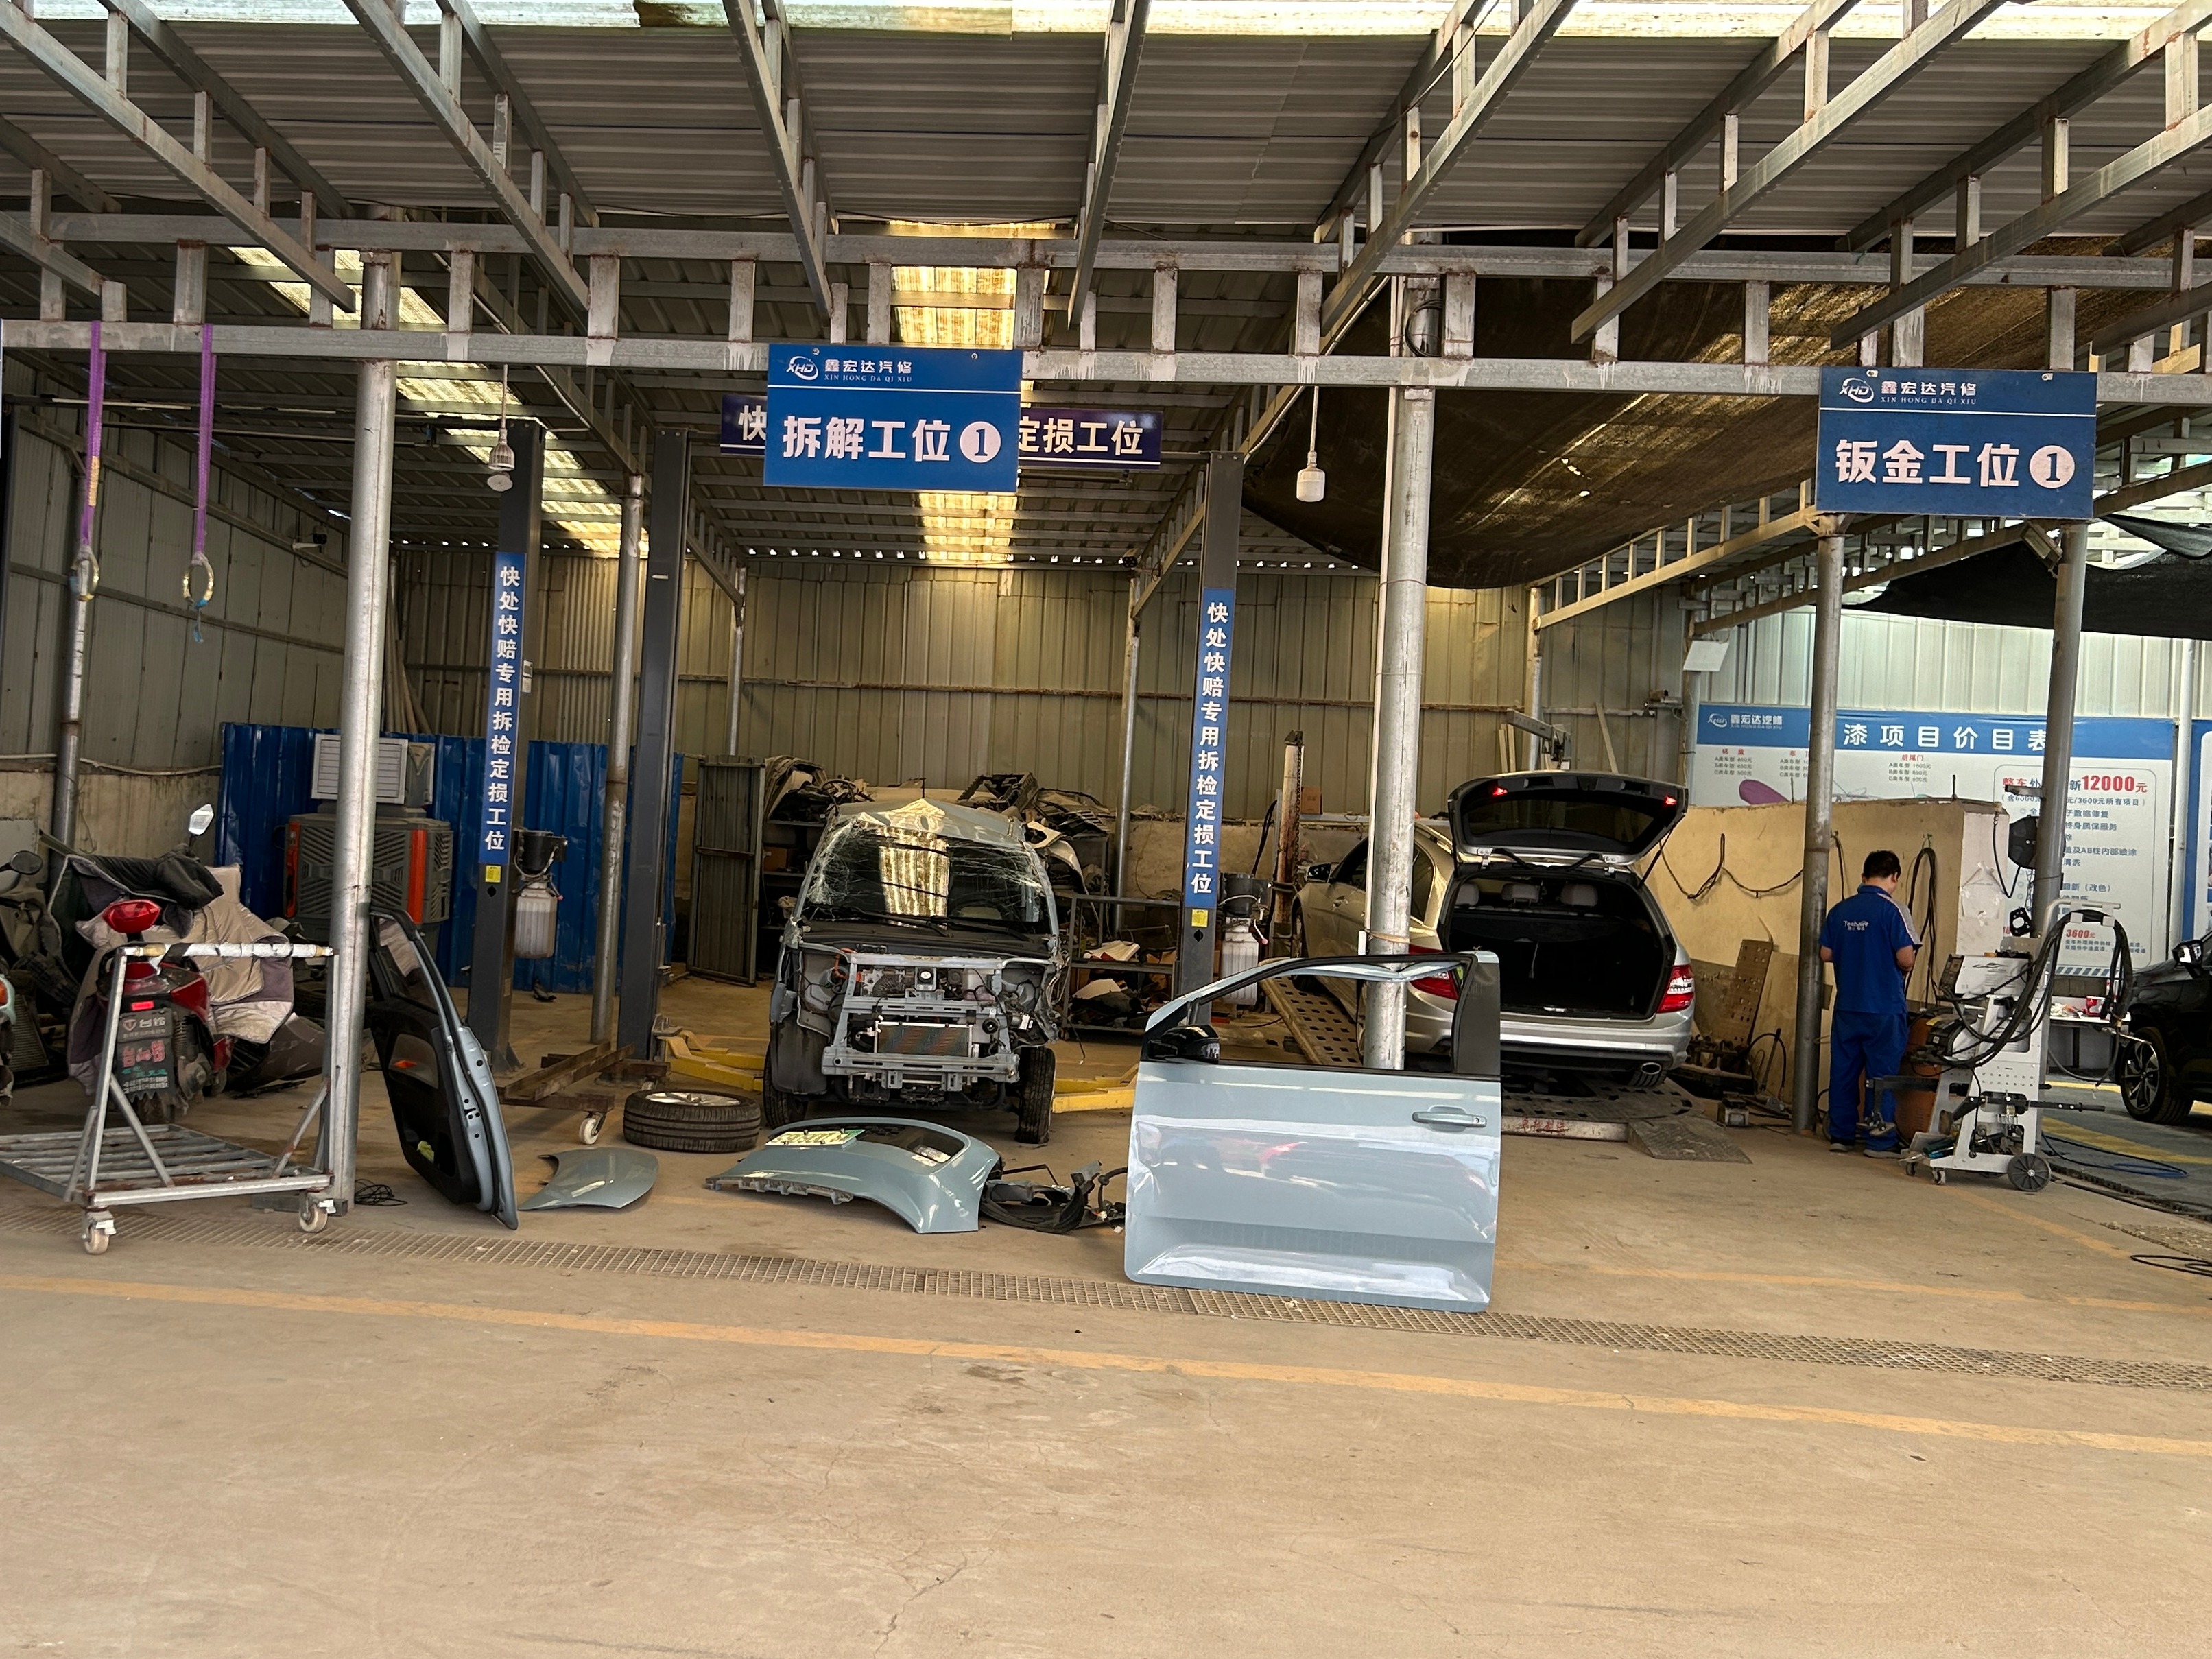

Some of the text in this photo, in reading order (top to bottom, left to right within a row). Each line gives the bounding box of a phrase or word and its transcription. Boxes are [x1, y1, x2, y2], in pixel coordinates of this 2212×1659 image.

[787, 362, 815, 373] XHD
[824, 359, 912, 374] 鑫宏达汽修
[1839, 385, 1870, 396] XHD
[1880, 381, 1977, 396] 鑫宏达汽修
[738, 405, 1143, 456] 快 定损工位
[485, 565, 521, 851] 快处快赔专用拆检定损工位
[1808, 723, 2047, 752] 漆项目价目表
[1190, 601, 1229, 895] 快处快赔专用拆检定损工位
[2065, 929, 2095, 939] 3600元
